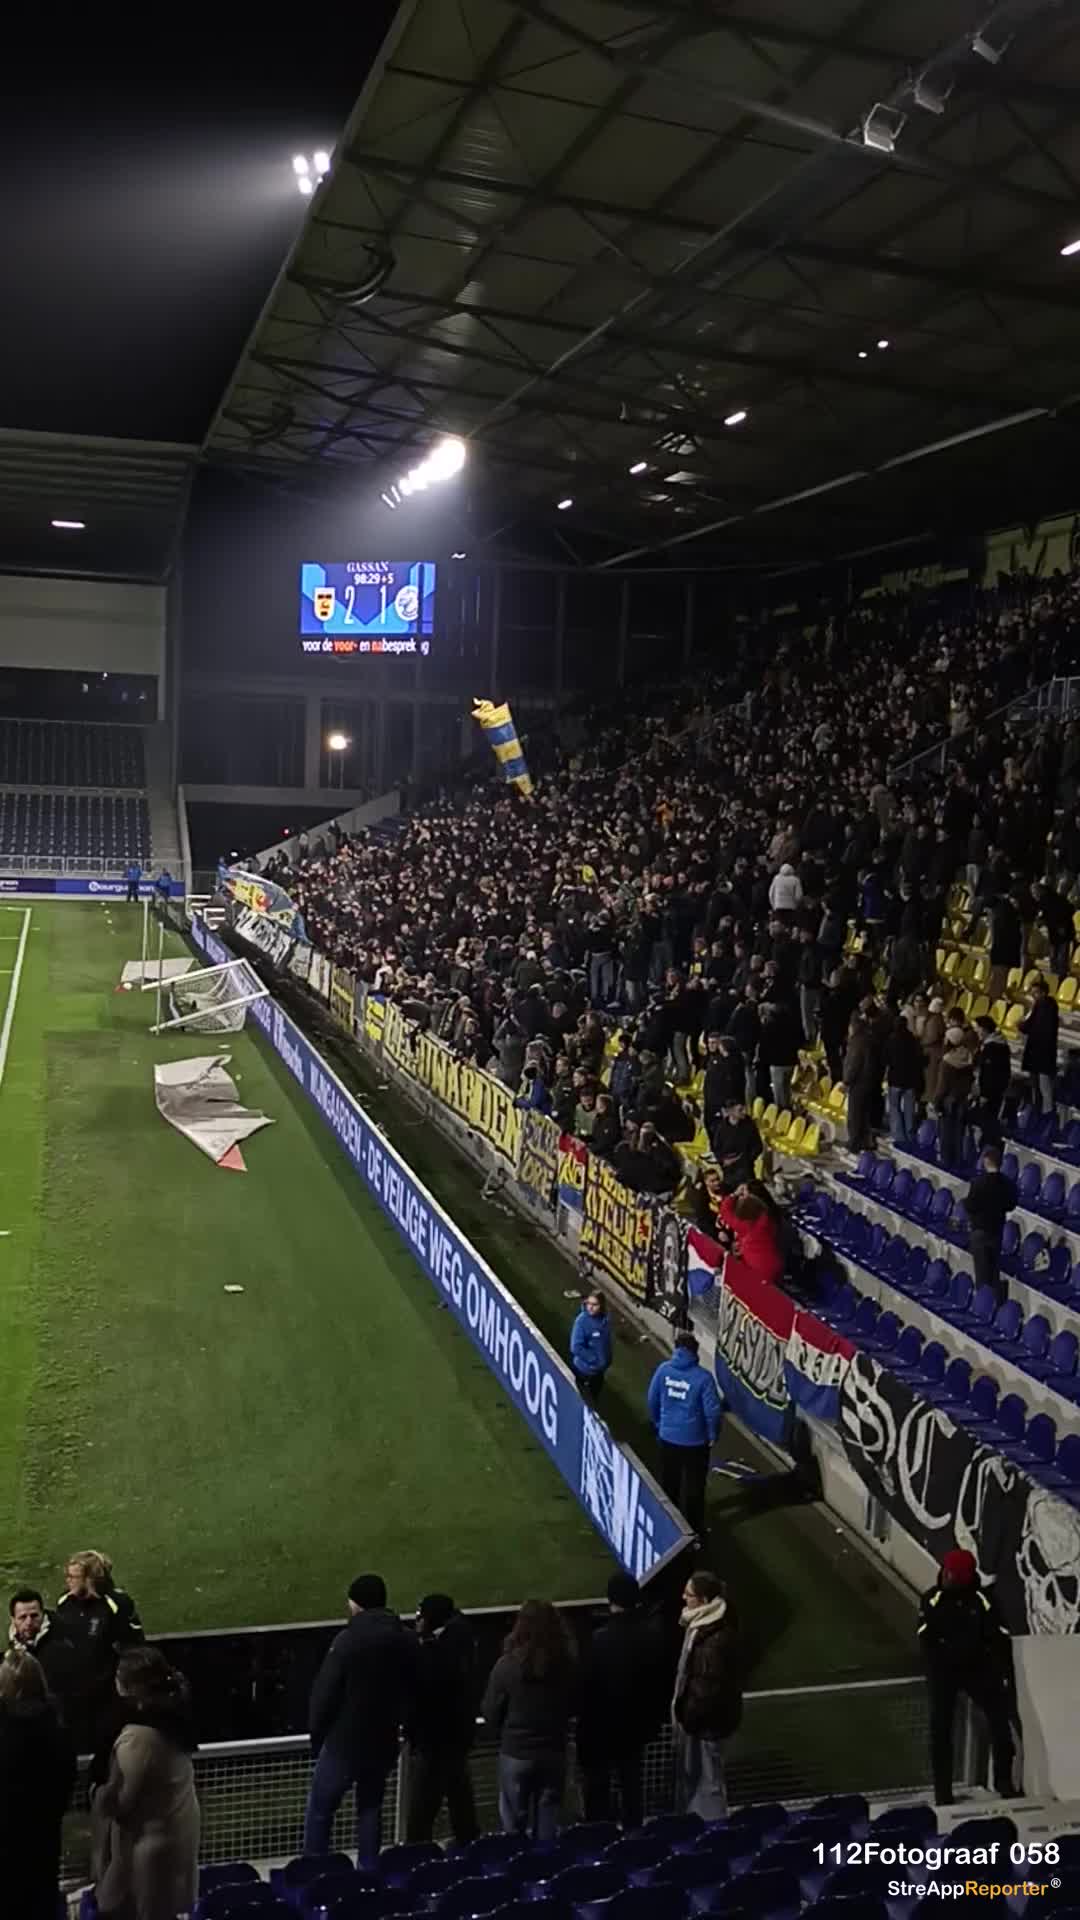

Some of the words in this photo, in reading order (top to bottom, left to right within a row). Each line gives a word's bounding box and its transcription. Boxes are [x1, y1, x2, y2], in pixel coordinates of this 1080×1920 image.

[347, 561, 389, 572] GASSAN
[344, 585, 355, 624] 2
[380, 585, 387, 624] 1
[303, 640, 321, 651] voor
[322, 638, 333, 651] de
[360, 640, 370, 652] en
[367, 1139, 382, 1192] DE
[383, 1159, 428, 1257] VEILIGE
[429, 1219, 464, 1309] WEG
[466, 1272, 558, 1447] OMHOOG
